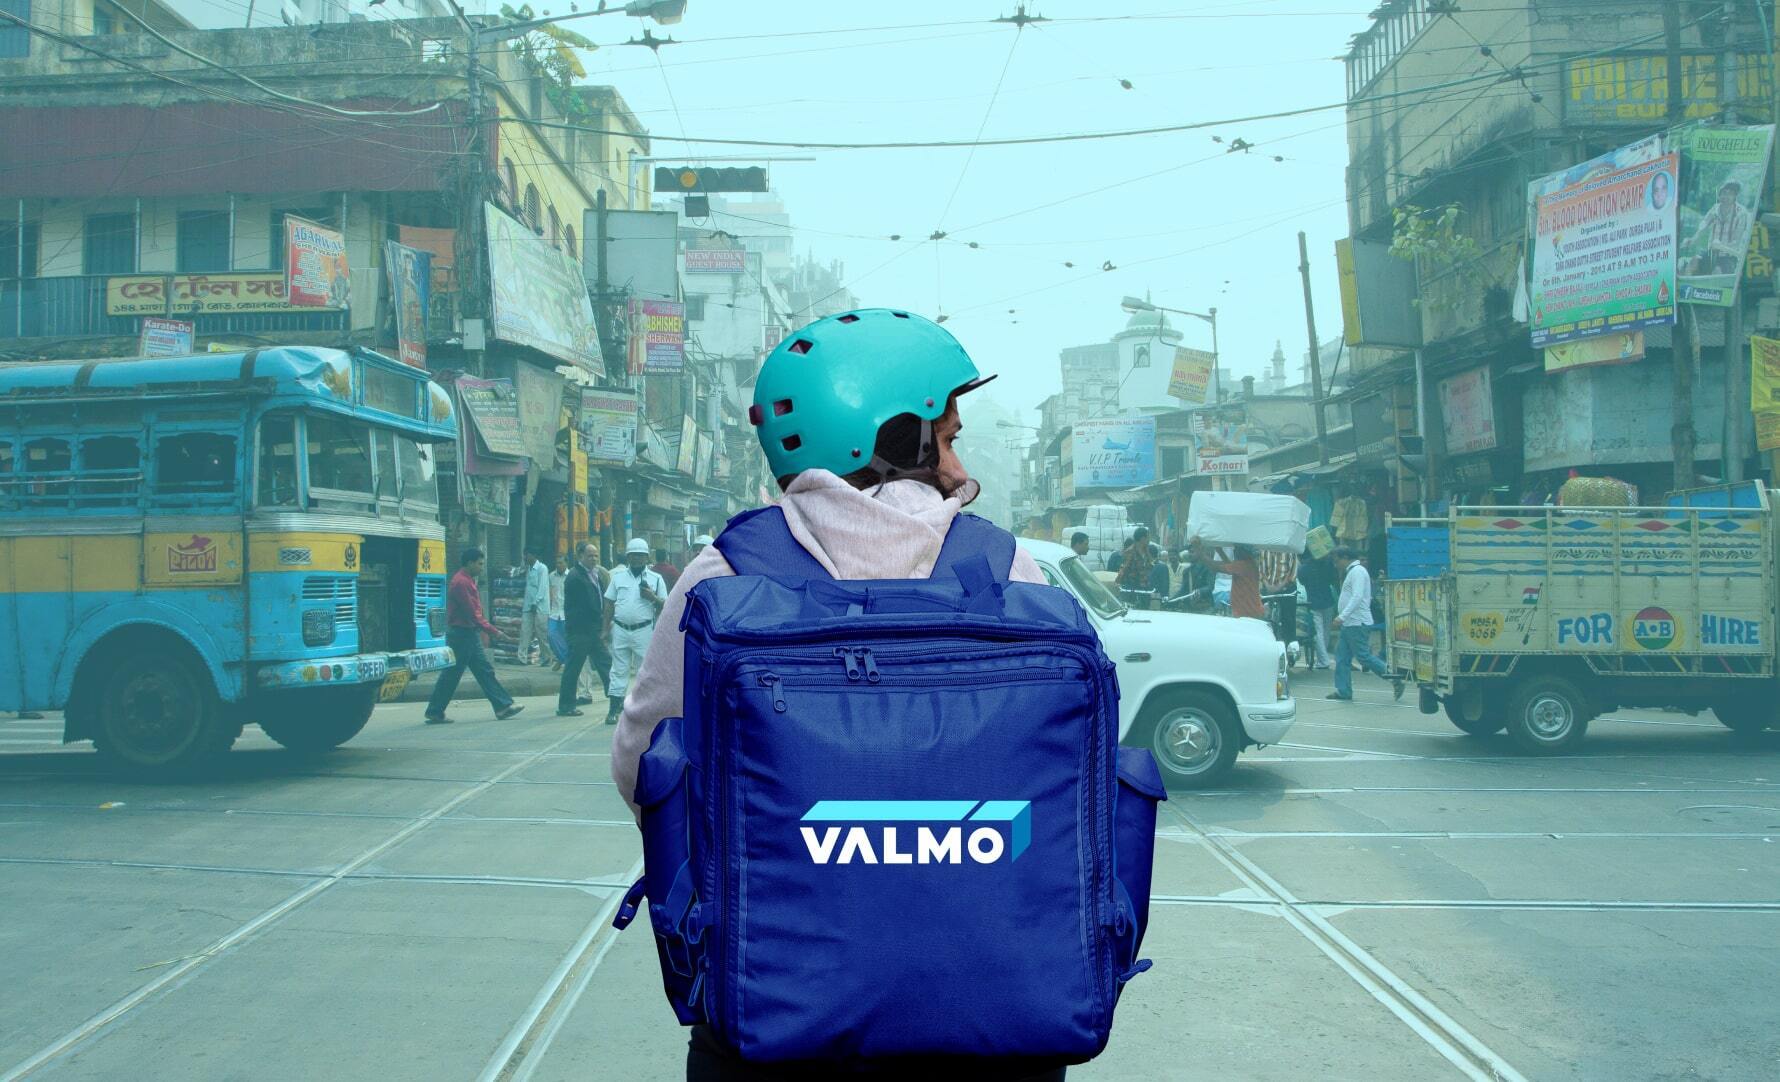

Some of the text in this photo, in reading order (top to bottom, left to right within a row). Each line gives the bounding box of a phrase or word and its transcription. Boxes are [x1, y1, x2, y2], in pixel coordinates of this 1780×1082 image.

[1552, 207, 1576, 230] BLOOD
[1577, 195, 1617, 223] DONATION
[1619, 186, 1644, 211] CAMP
[1563, 271, 1586, 282] January
[1590, 265, 1606, 274] 2013
[1607, 263, 1616, 271] AT
[1638, 255, 1649, 264] TO
[144, 319, 191, 333] Karate-Do
[1557, 612, 1613, 644] FOR
[1700, 613, 1761, 645] HIRE
[799, 826, 1005, 865] VALMO
